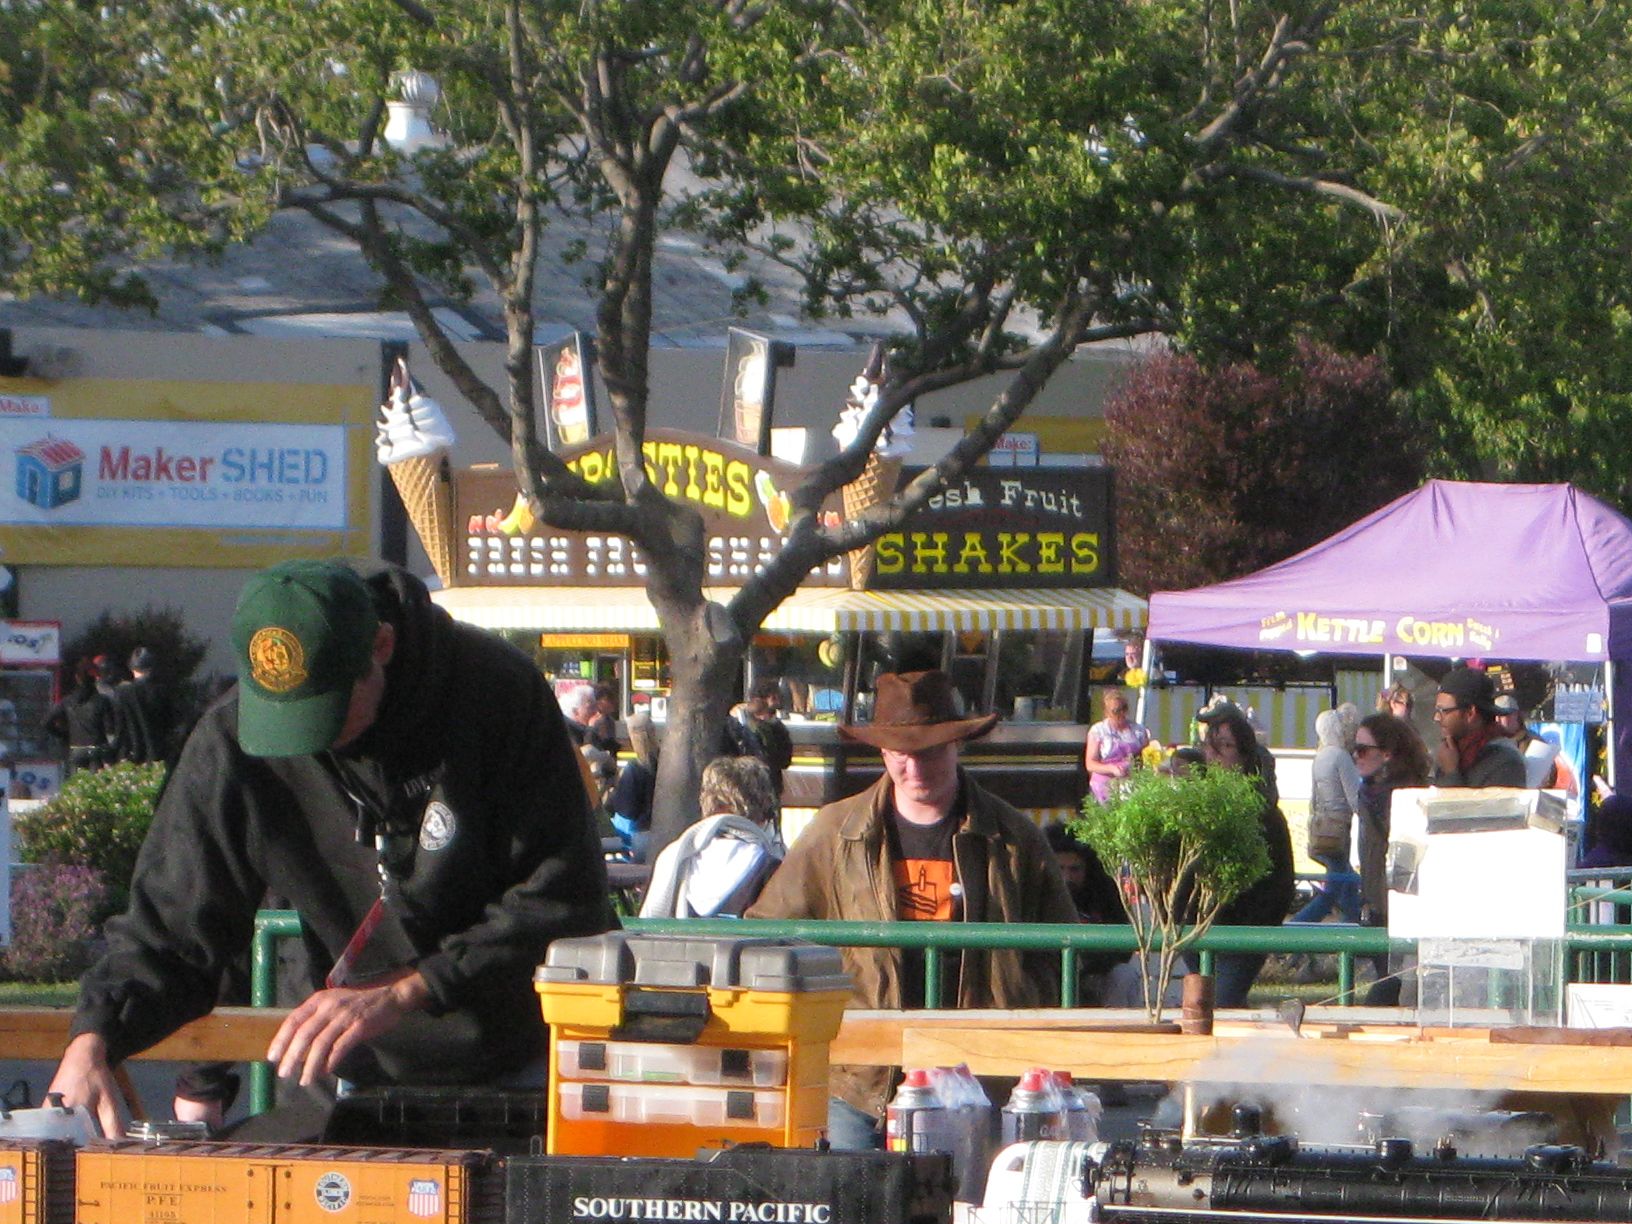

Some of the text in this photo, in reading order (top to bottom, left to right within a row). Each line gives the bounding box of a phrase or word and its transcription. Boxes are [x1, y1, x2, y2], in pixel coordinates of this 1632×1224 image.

[100, 446, 328, 484] Maker SHED
[170, 486, 217, 500] TOOLS
[234, 487, 283, 501] BOOKS
[1000, 480, 1083, 517] Fruit
[876, 532, 1099, 575] SHAKES
[1296, 612, 1387, 643] KETTLE
[1396, 616, 1465, 646] CORN
[573, 1197, 831, 1224] SOUTHERN PACIFIC
